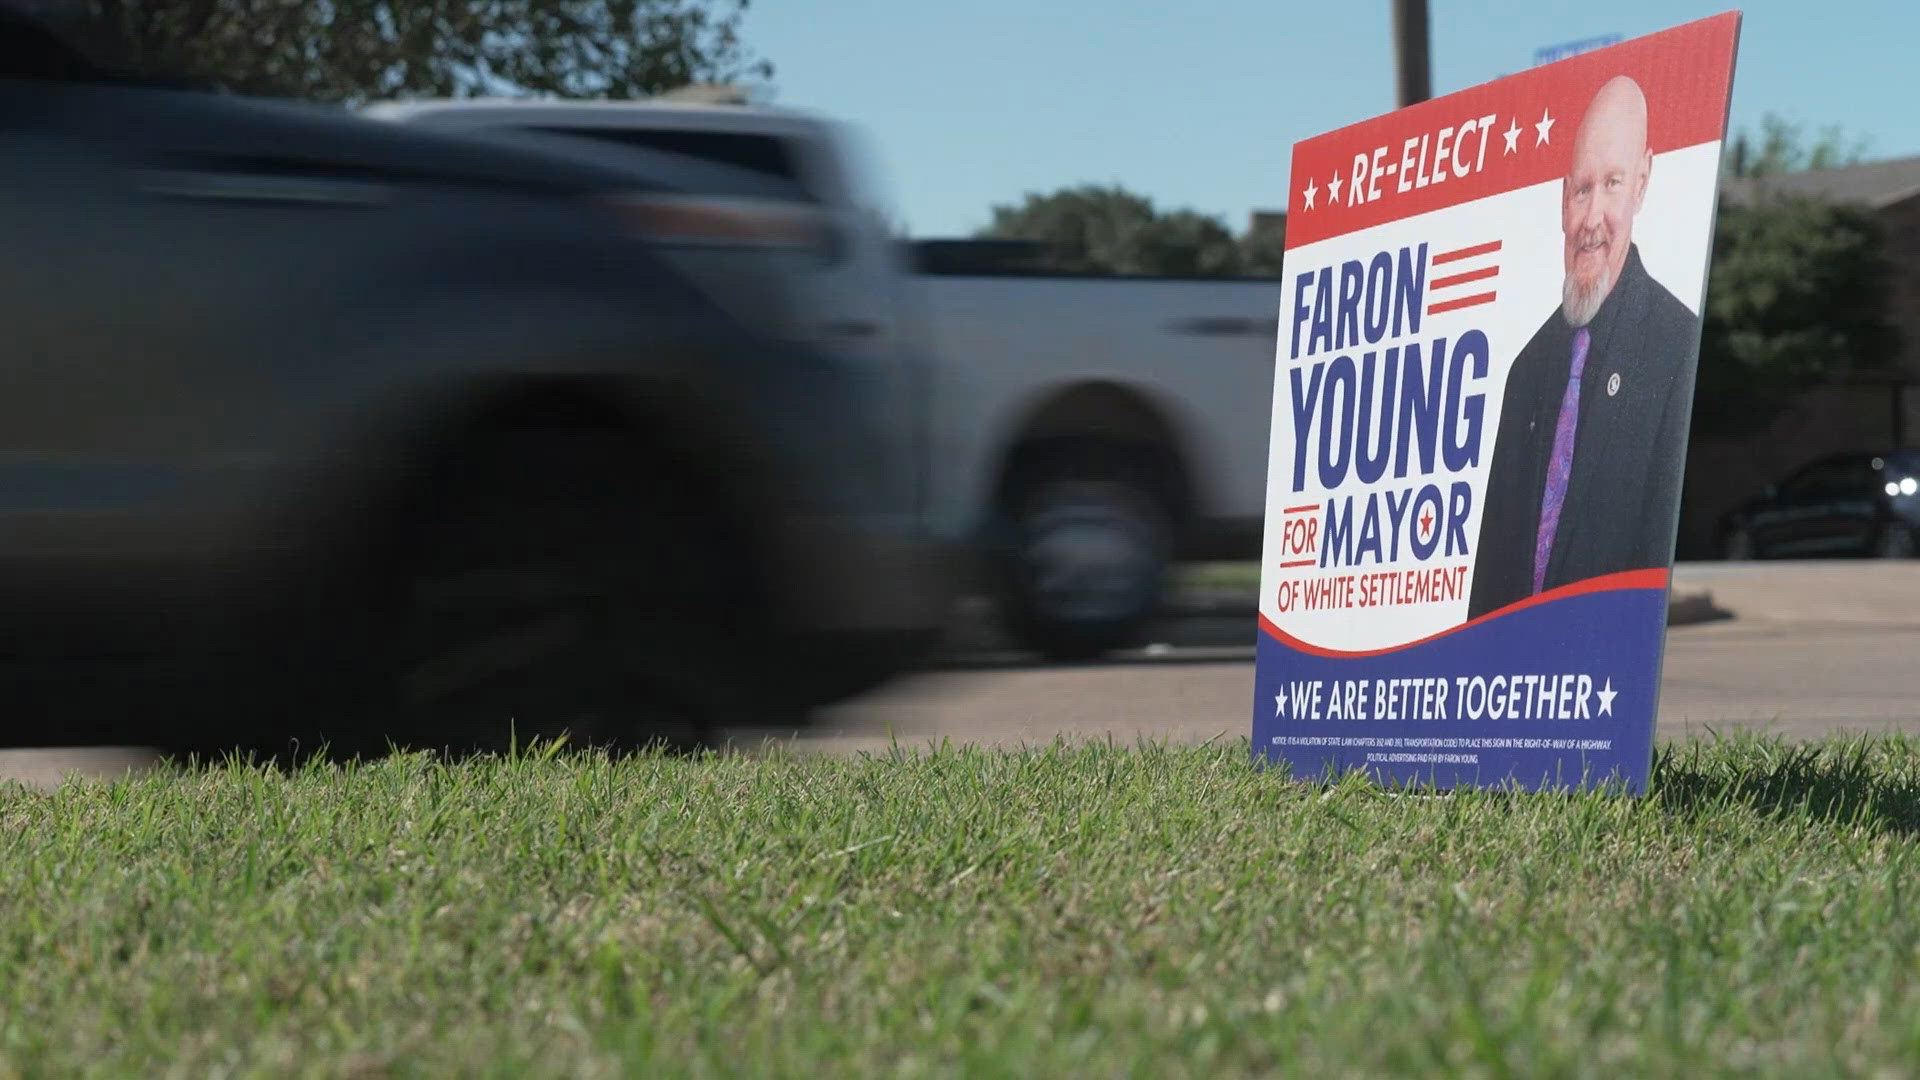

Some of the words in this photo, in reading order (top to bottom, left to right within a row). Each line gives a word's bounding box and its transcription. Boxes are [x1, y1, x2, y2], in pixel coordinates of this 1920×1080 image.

[1348, 113, 1497, 208] RE-ELECT
[1290, 242, 1428, 359] FARON
[1290, 329, 1490, 493] YOUNG
[1282, 517, 1318, 556] FOR
[1320, 481, 1472, 568] MAYOR
[1278, 580, 1299, 613] OF
[1303, 576, 1354, 612] WHITE
[1358, 565, 1468, 608] SETTLEMENT
[1290, 680, 1322, 720] WE
[1326, 679, 1369, 720] ARE
[1374, 677, 1449, 720] BETTER
[1456, 674, 1593, 720] TOGETHER
[1327, 736, 1341, 746] STATE
[1384, 737, 1394, 747] AND
[1404, 737, 1443, 747] TRANSPORTATION
[1459, 738, 1465, 748] TO
[1466, 738, 1480, 748] PLACE
[1482, 738, 1492, 748] THIS
[1492, 738, 1505, 748] SIGN
[1505, 738, 1512, 748] IN
[1513, 738, 1524, 748] THE
[1567, 739, 1575, 749] OF
[1367, 752, 1388, 762] POLITICAL
[1388, 752, 1417, 763] ADVERTISING
[1417, 753, 1427, 763] PAID
[1428, 753, 1437, 763] FOR
[1444, 754, 1460, 763] FARON
